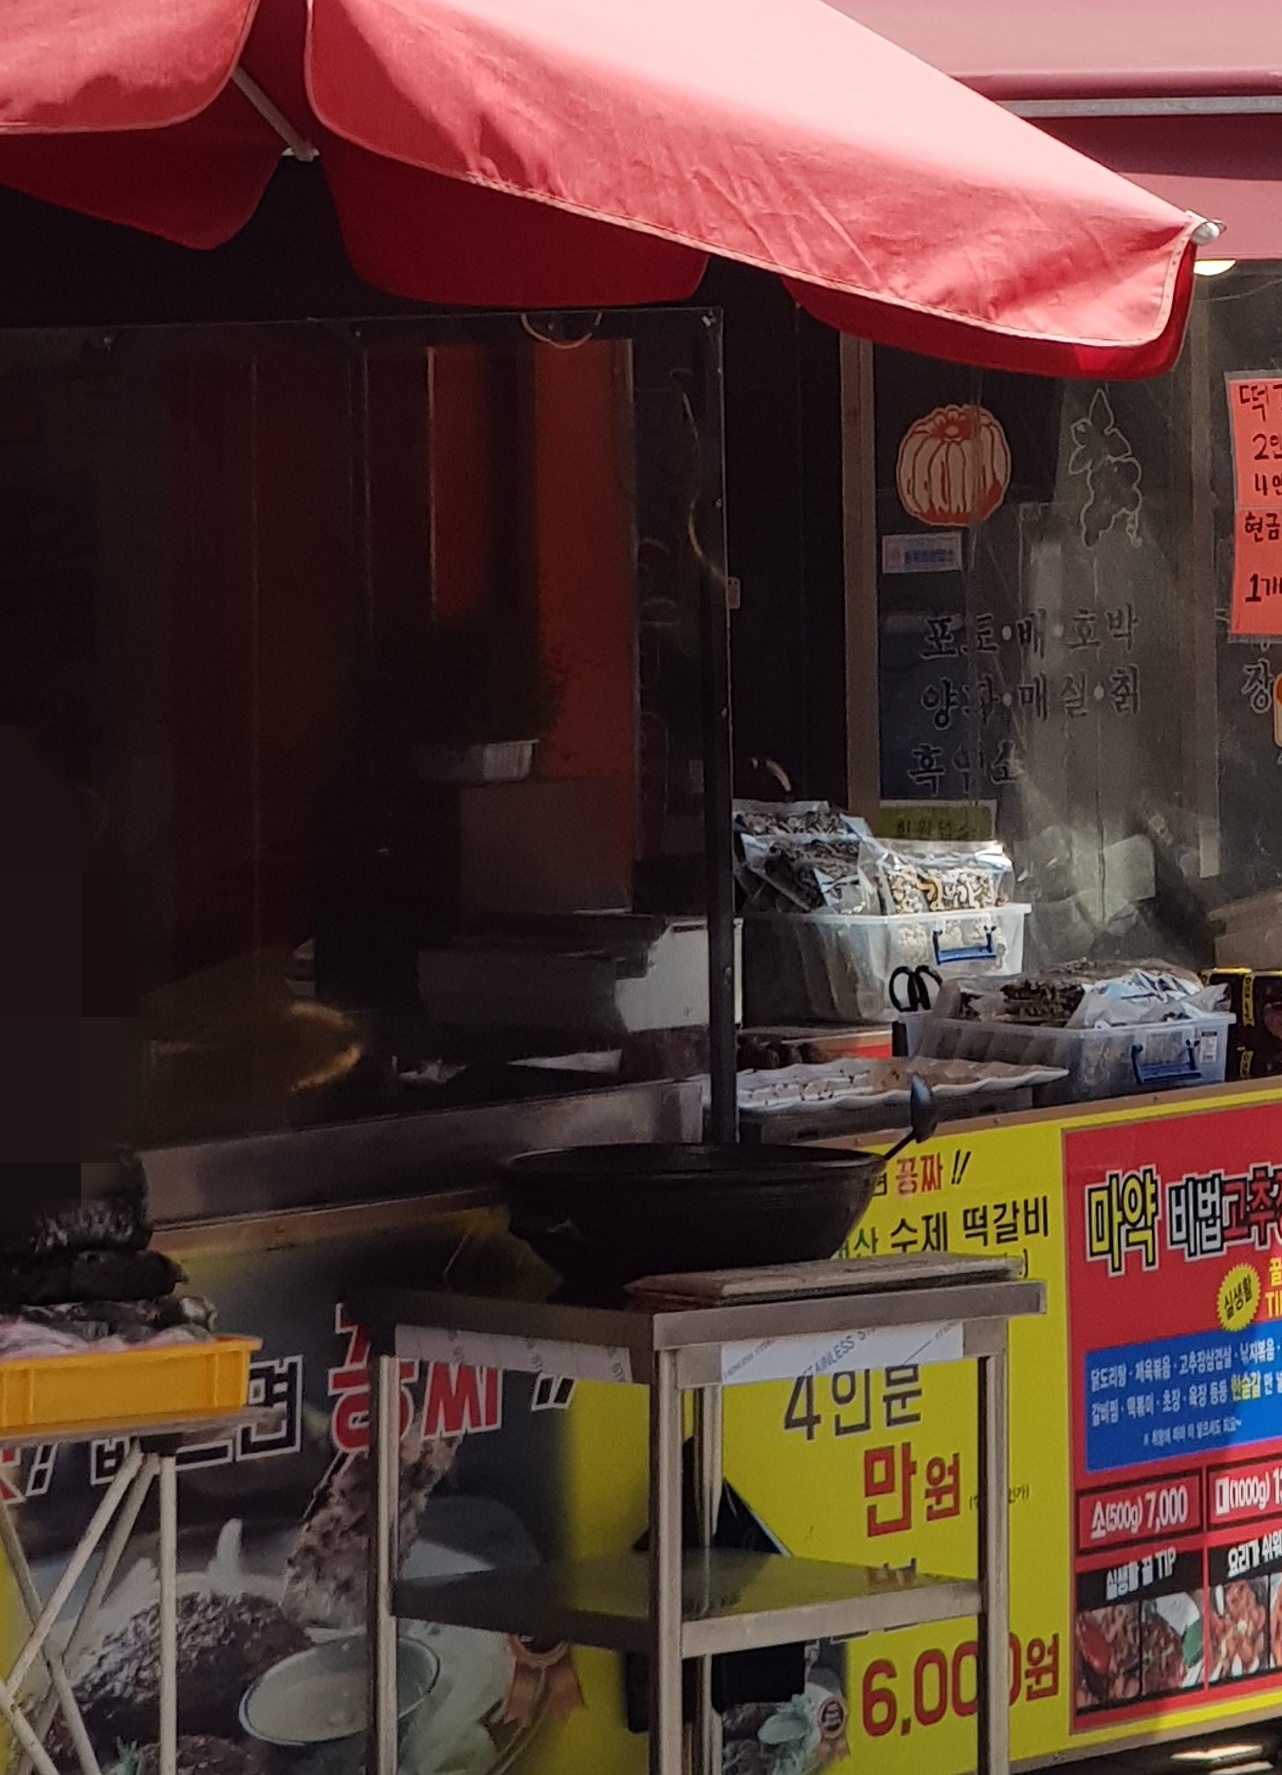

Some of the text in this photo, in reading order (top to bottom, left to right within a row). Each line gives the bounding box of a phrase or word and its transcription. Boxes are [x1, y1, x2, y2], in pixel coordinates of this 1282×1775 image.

[890, 1210, 949, 1253] 수제
[962, 1195, 1049, 1247] 떡갈비
[1085, 1164, 1163, 1279] 마약
[863, 1441, 961, 1538] 만원
[1145, 1484, 1189, 1533] 7,000
[1155, 1545, 1178, 1580] TIP
